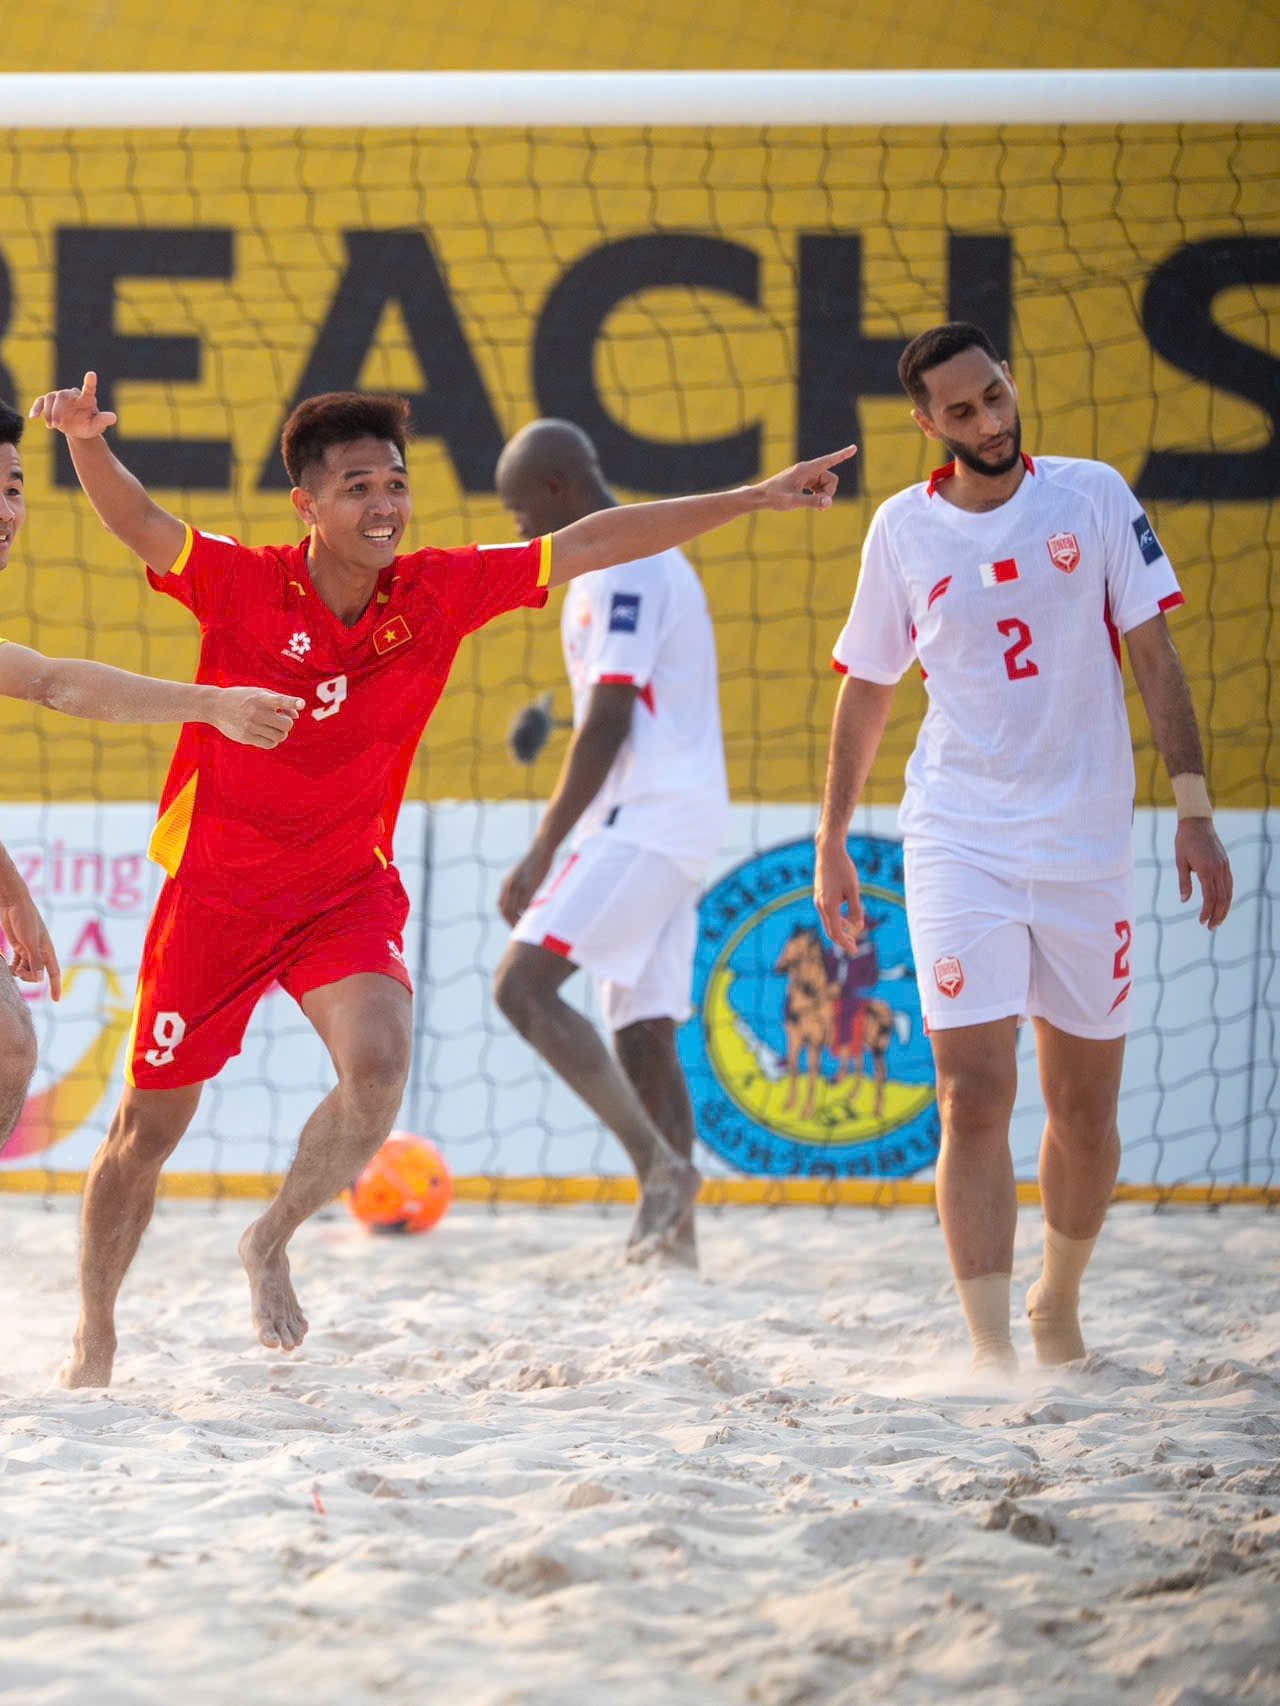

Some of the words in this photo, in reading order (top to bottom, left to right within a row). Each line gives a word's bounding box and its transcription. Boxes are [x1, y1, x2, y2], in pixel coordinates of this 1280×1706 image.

[997, 618, 1040, 681] 2
[311, 674, 348, 721] 9
[1113, 920, 1132, 980] 2
[144, 1011, 186, 1067] 9
